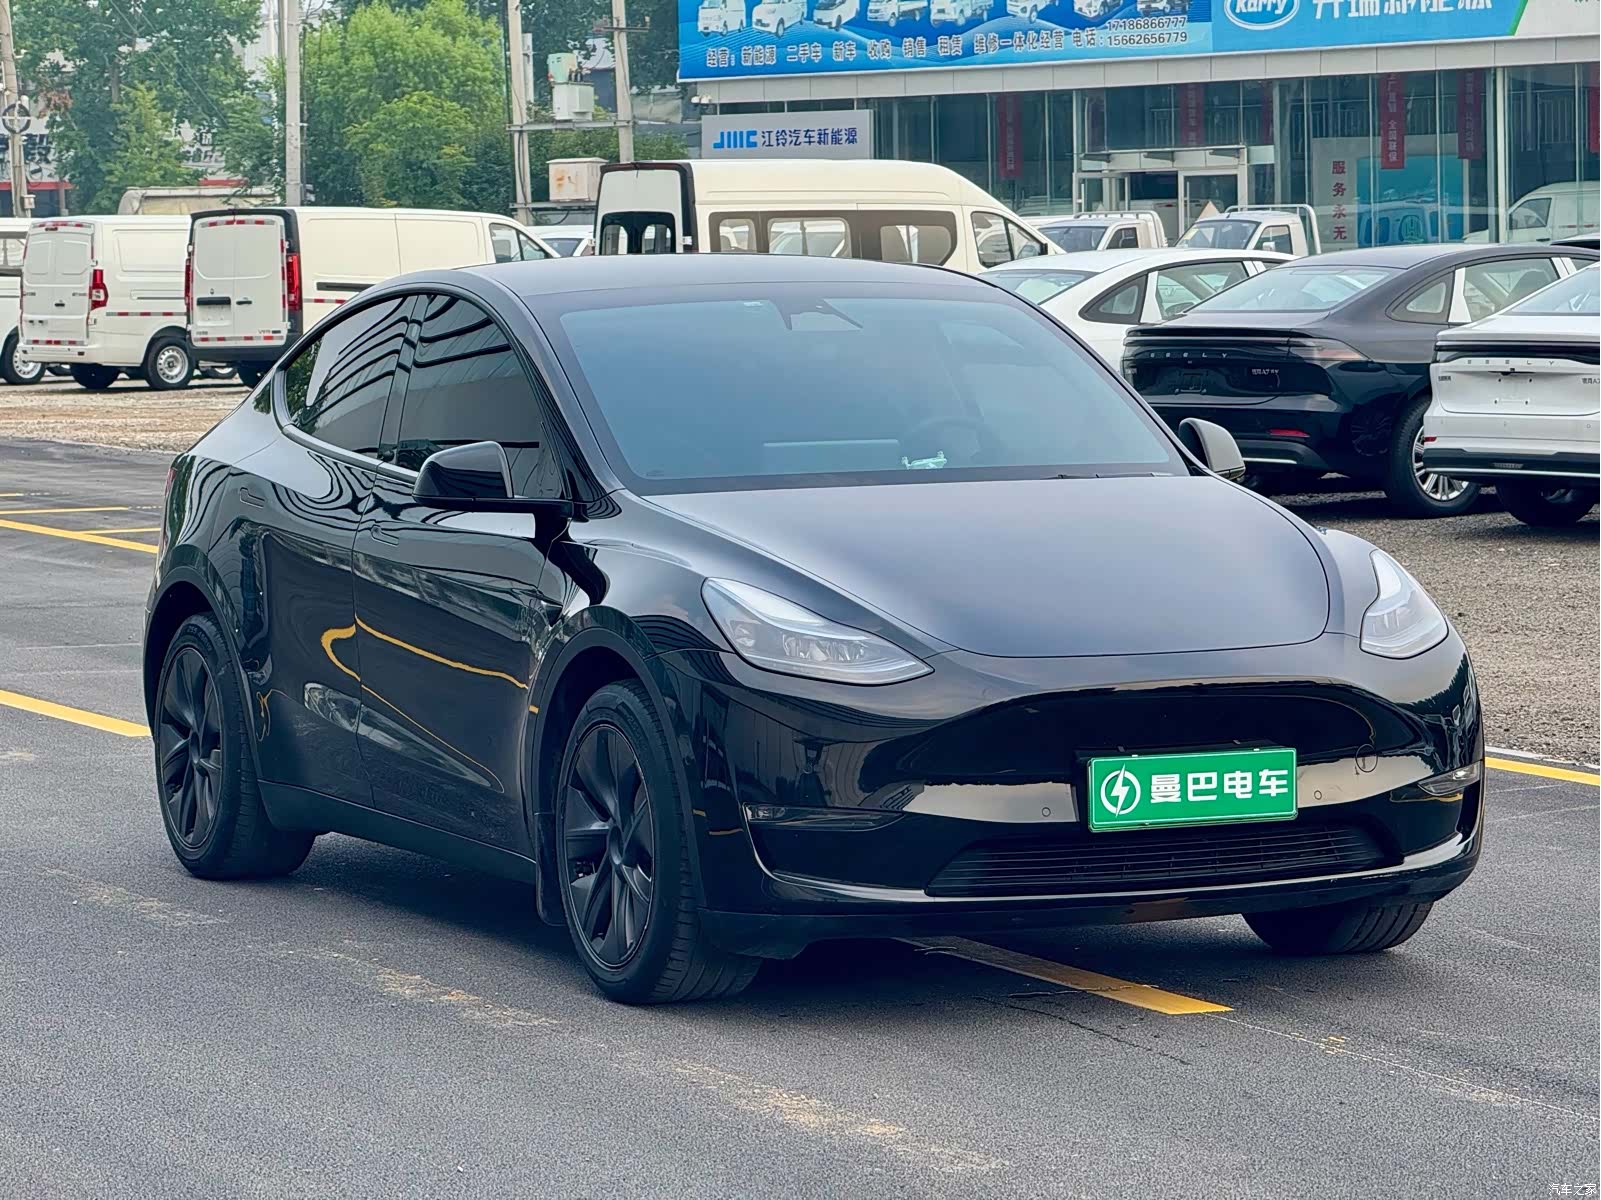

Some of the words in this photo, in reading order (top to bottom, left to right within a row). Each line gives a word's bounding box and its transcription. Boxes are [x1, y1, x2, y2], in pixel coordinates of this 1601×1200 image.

[1107, 15, 1187, 31] 17186866777
[706, 47, 735, 68] 经营：
[741, 45, 777, 66] 新能源
[786, 42, 822, 63] 二手车
[832, 40, 856, 61] 新车
[867, 38, 892, 60] 收购
[902, 36, 927, 58] 销售
[938, 34, 963, 56] 租赁
[973, 29, 1064, 54] 维修一体化经营
[1107, 31, 1188, 47] 15662656779
[761, 127, 858, 148] 江铃汽车新能源
[1331, 160, 1348, 250] 服务永无
[1150, 769, 1289, 804] 曼巴电车
